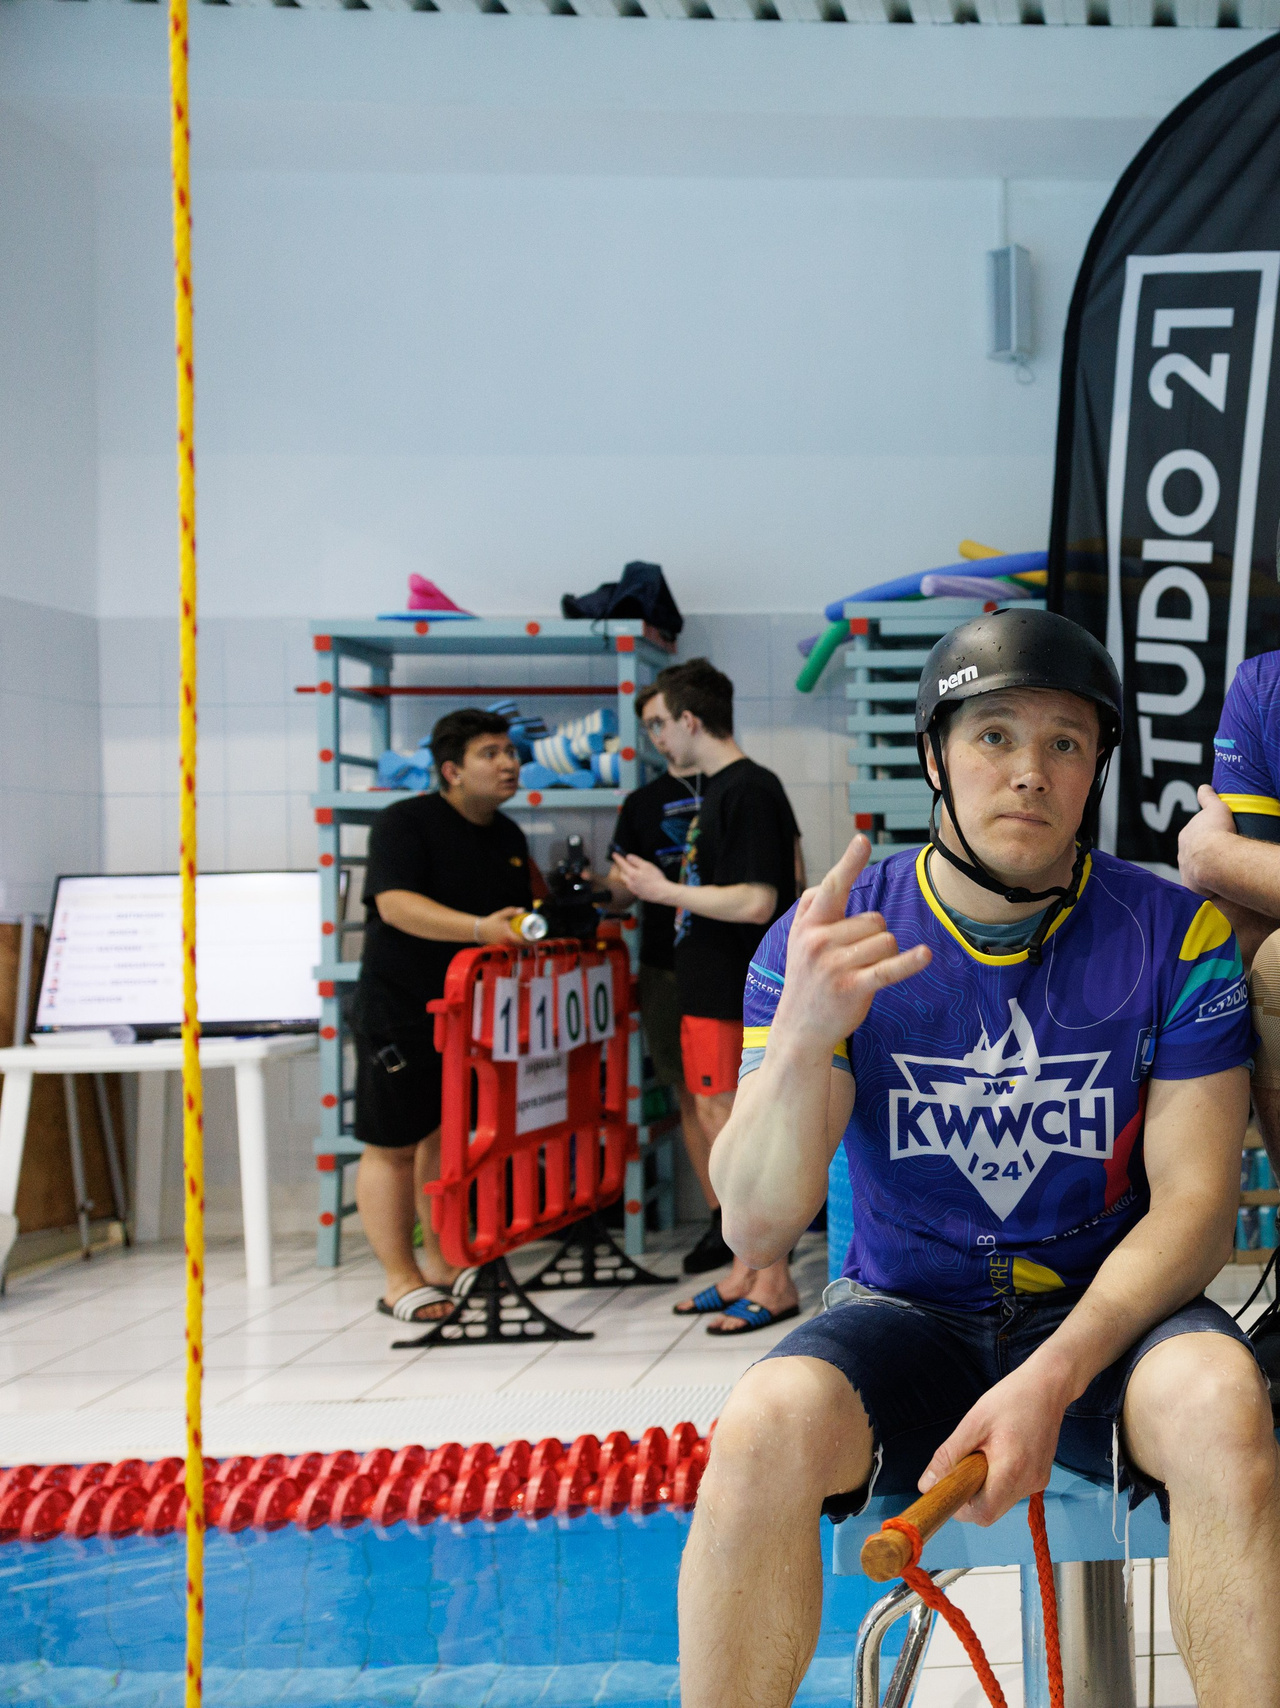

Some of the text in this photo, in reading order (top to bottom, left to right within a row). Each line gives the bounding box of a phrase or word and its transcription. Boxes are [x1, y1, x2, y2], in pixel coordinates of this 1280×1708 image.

[1134, 307, 1235, 833] STUDIO 21
[938, 665, 978, 697] bern
[897, 1096, 1107, 1152] KWWCH
[981, 1160, 1022, 1181] 24
